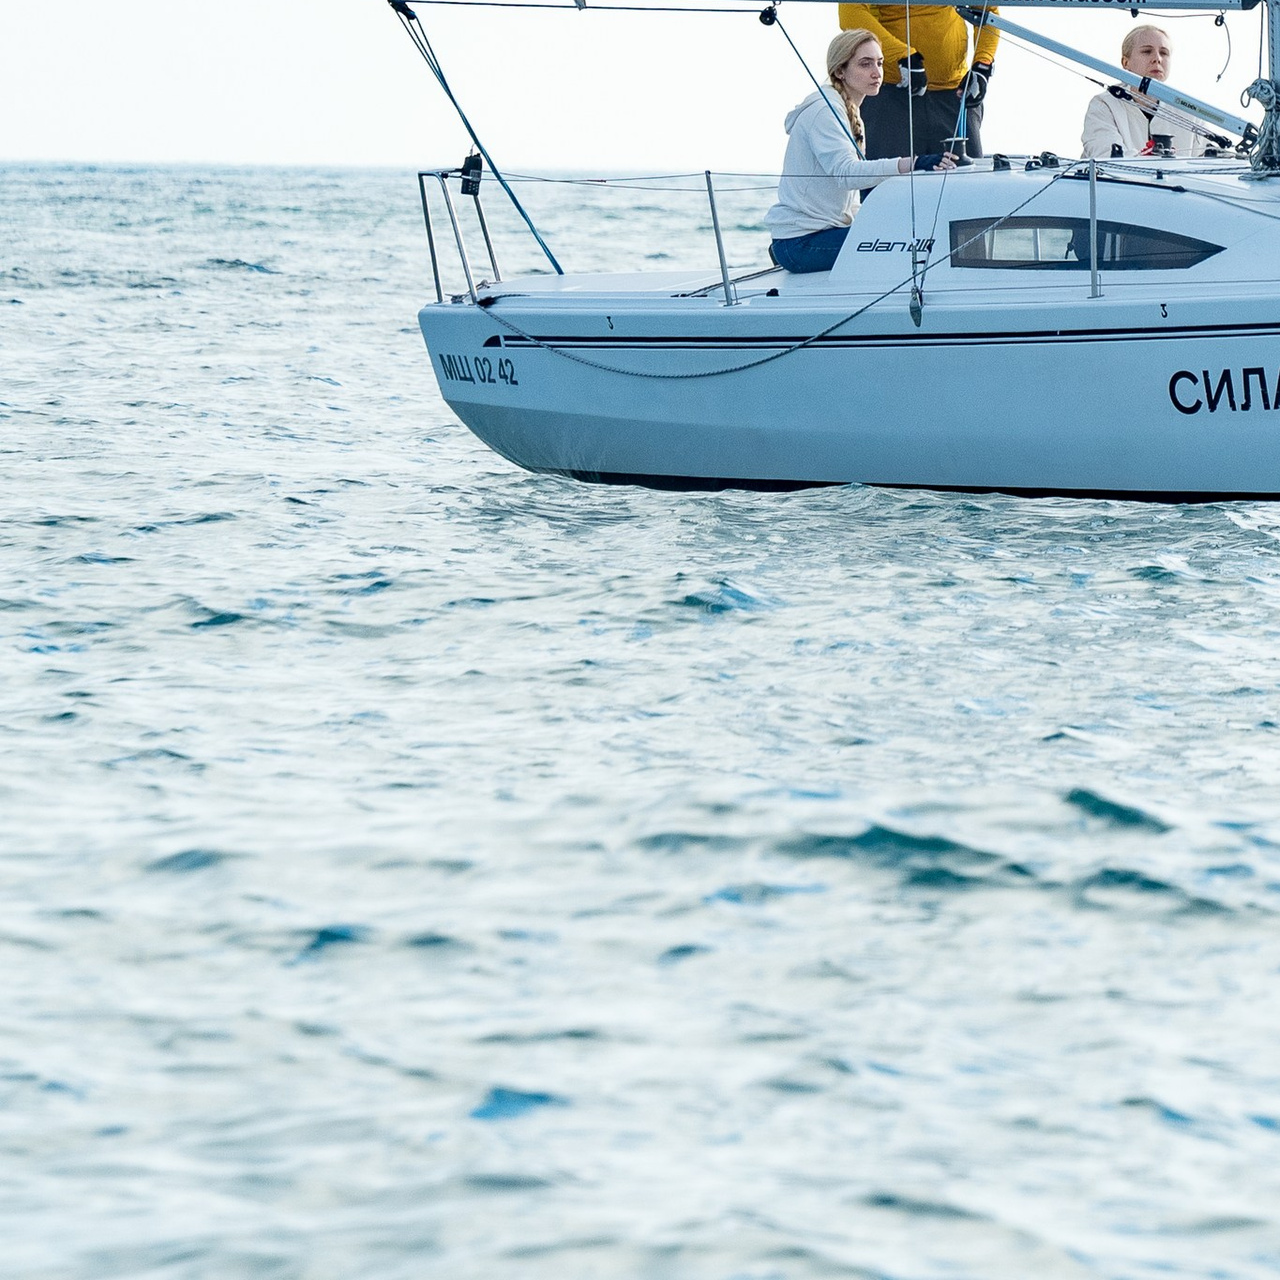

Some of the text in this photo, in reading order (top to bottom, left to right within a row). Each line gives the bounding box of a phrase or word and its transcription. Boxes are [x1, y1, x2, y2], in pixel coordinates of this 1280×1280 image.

[856, 238, 907, 252] elan
[439, 353, 519, 386] МЩ 02 42
